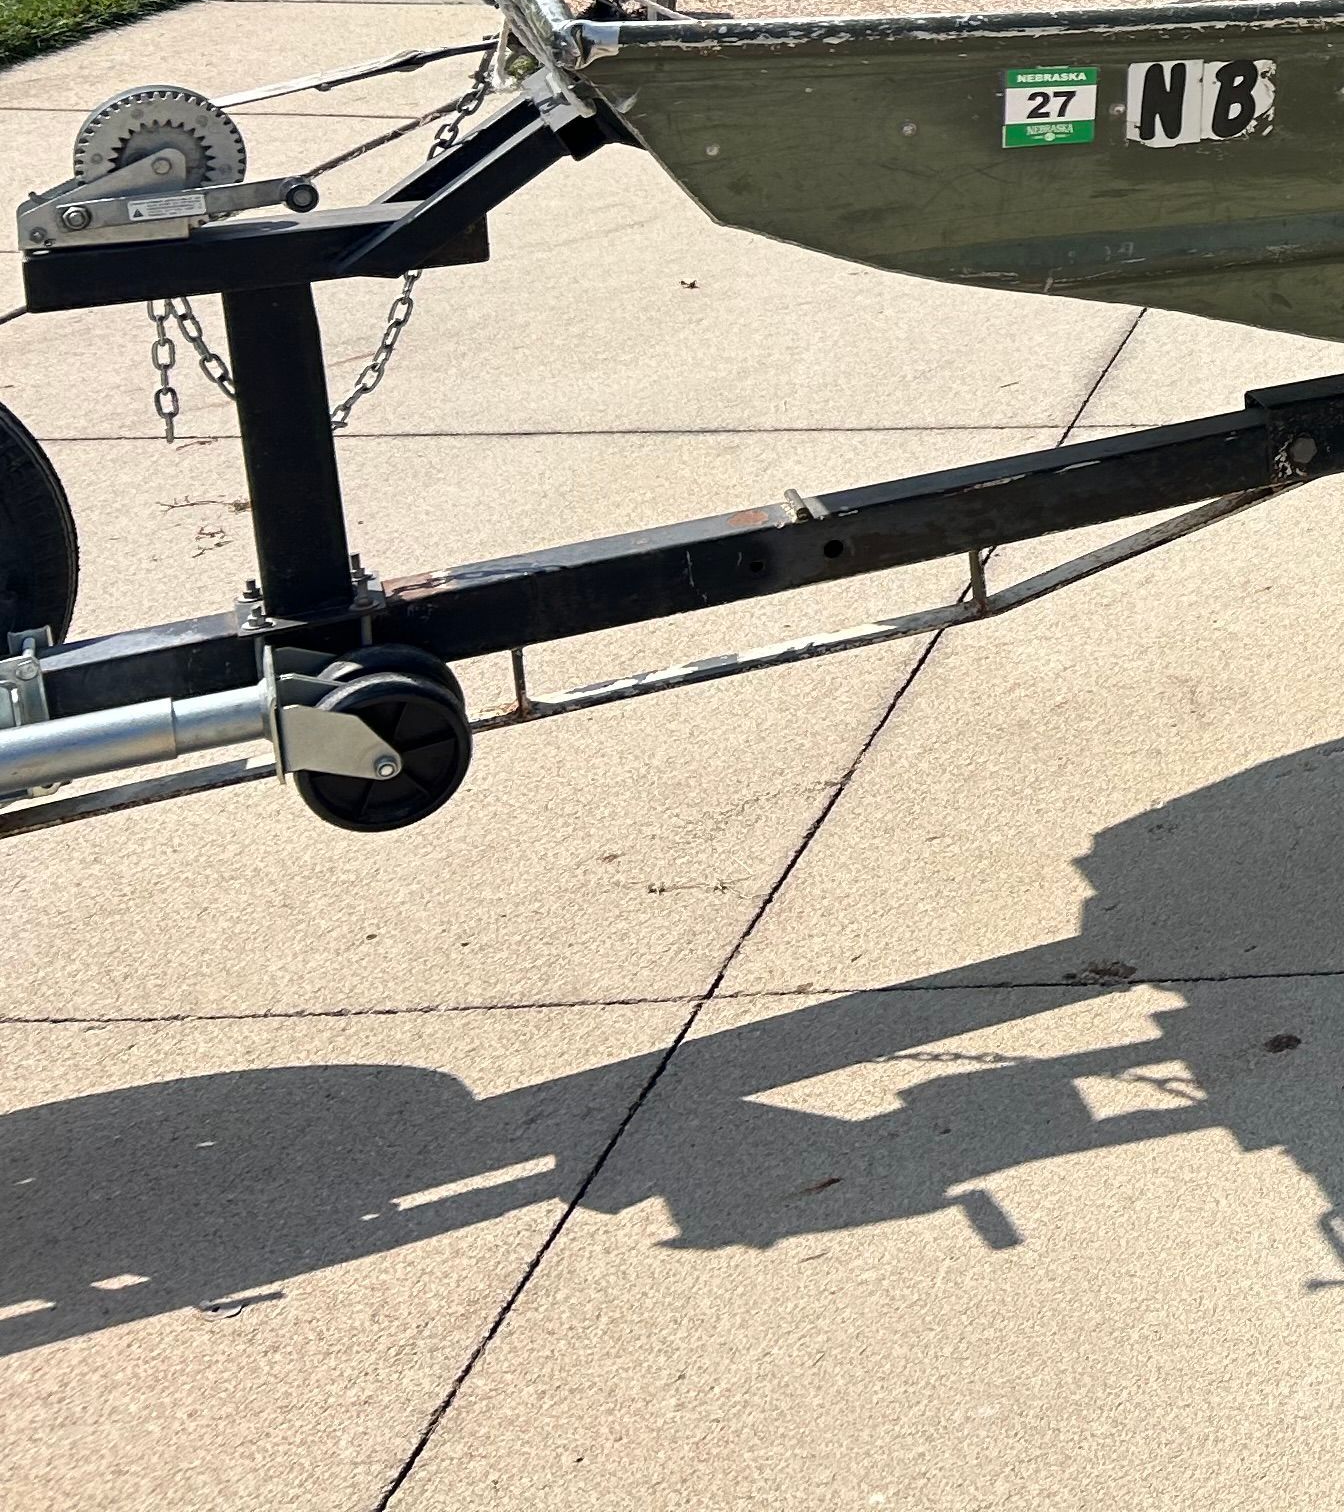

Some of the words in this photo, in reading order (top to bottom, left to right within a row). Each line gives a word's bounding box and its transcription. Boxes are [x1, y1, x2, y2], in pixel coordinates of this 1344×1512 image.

[1017, 72, 1087, 83] NEBRASKA
[1026, 90, 1077, 119] 27
[1139, 60, 1258, 140] NB
[1026, 124, 1074, 136] NEBRASKA
